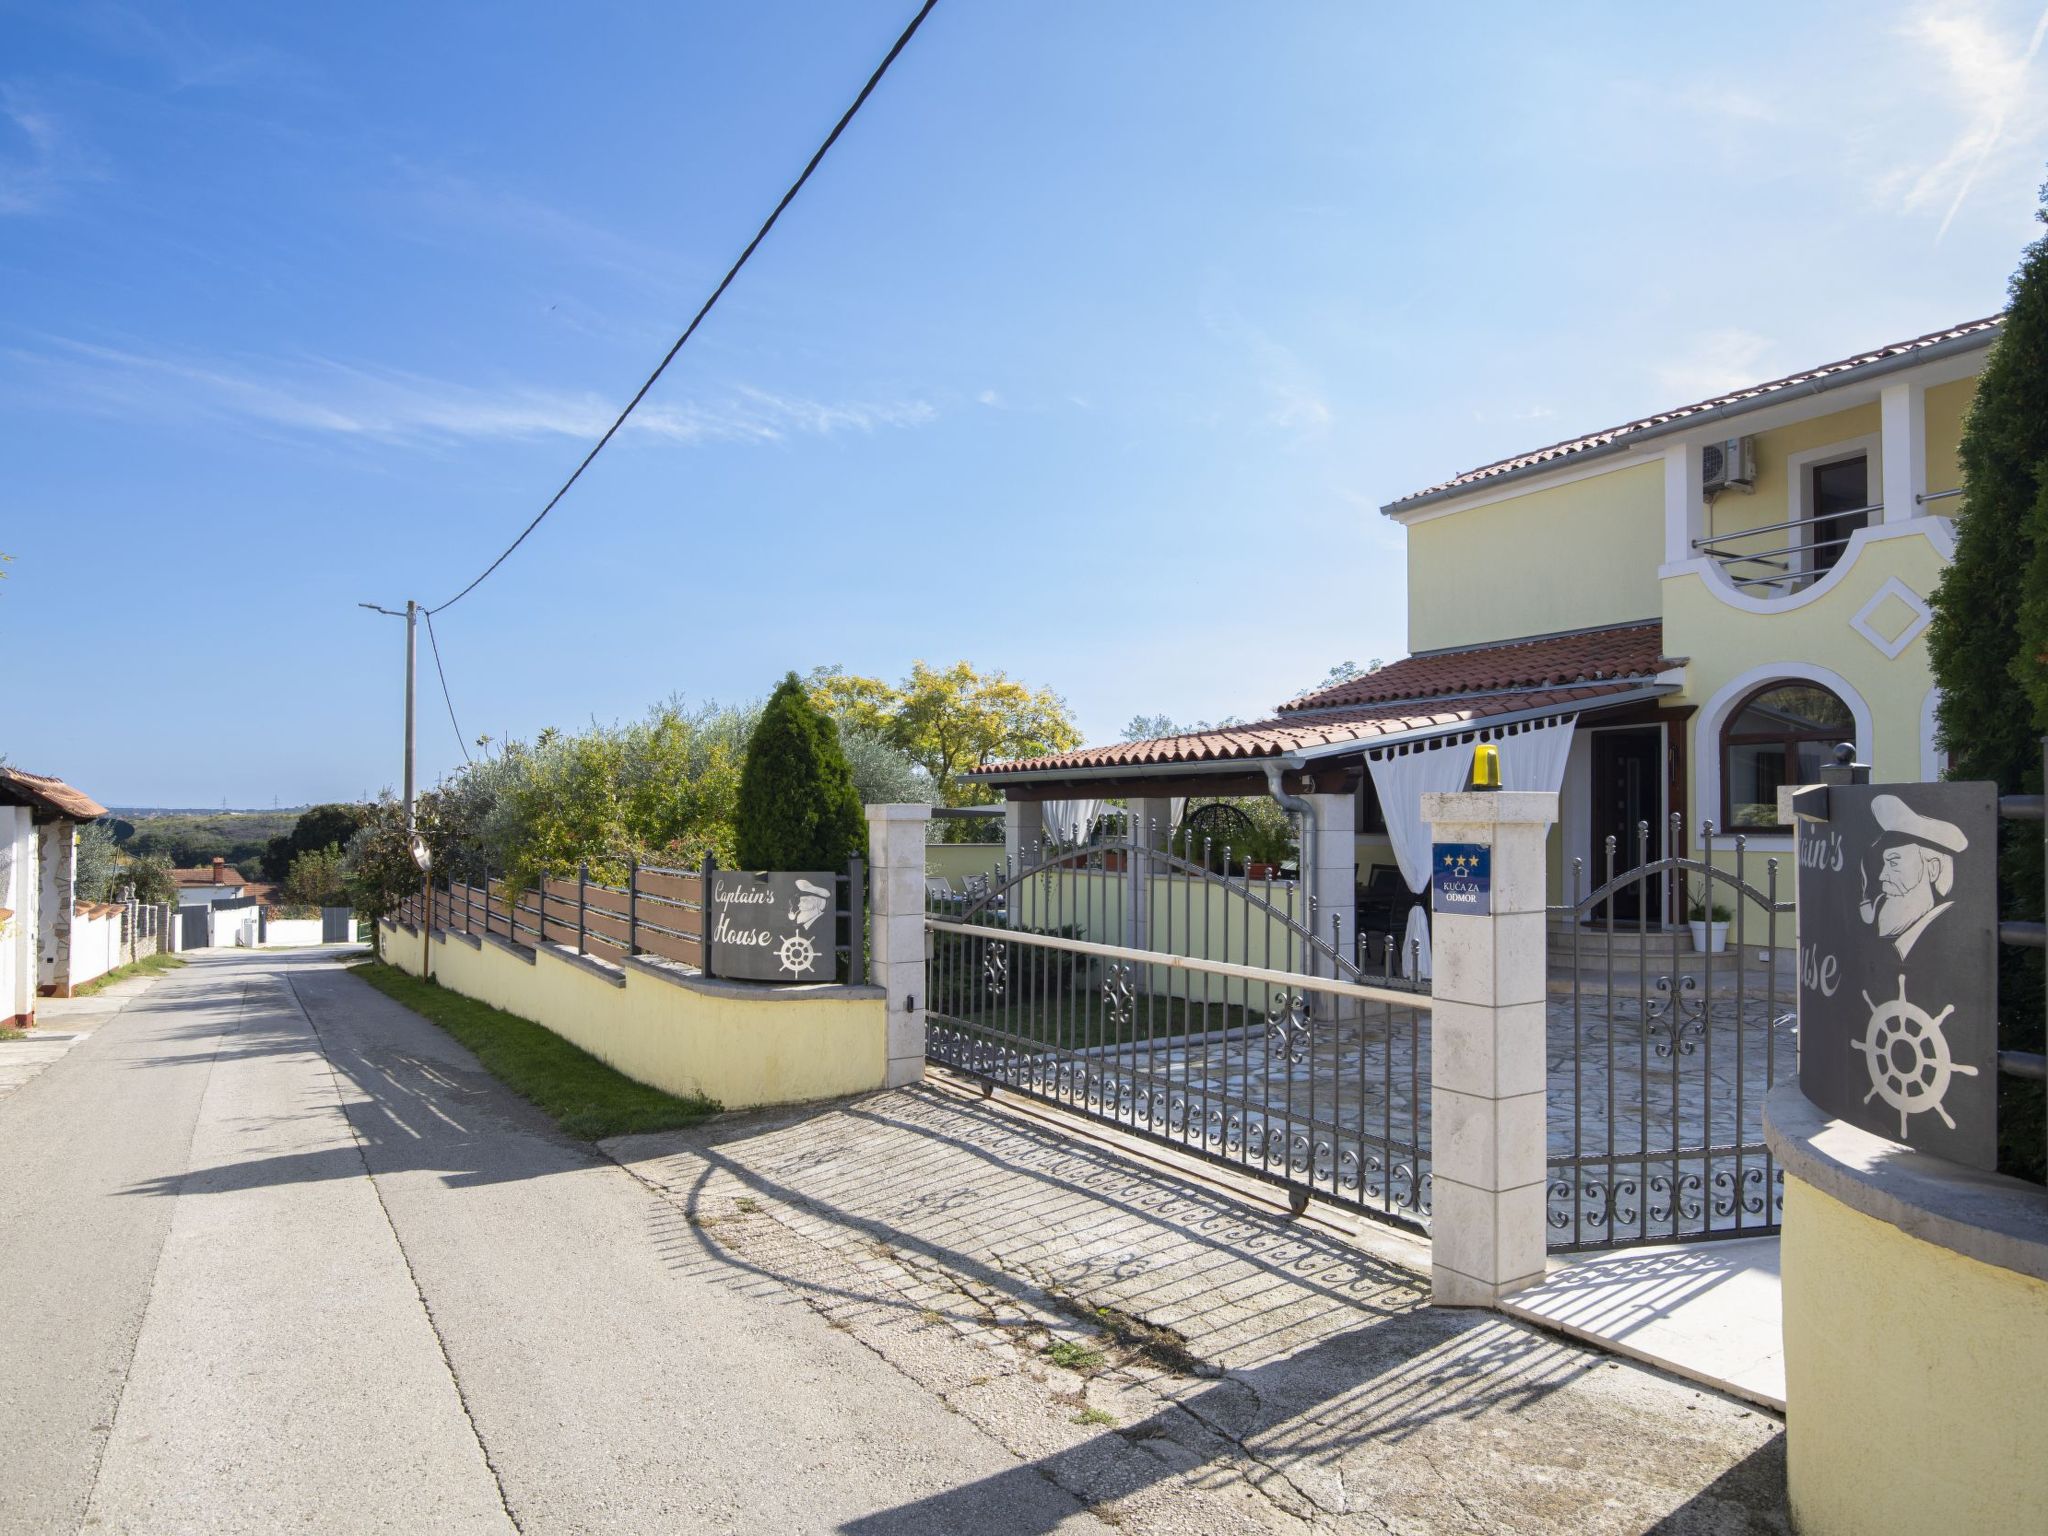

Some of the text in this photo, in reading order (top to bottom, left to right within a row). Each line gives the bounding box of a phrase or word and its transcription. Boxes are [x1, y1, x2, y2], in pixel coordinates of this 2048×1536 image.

[714, 880, 775, 912] Captain's
[1443, 881, 1479, 892] KUĆA ZA
[1446, 893, 1477, 903] ODMOR
[714, 913, 773, 946] House
